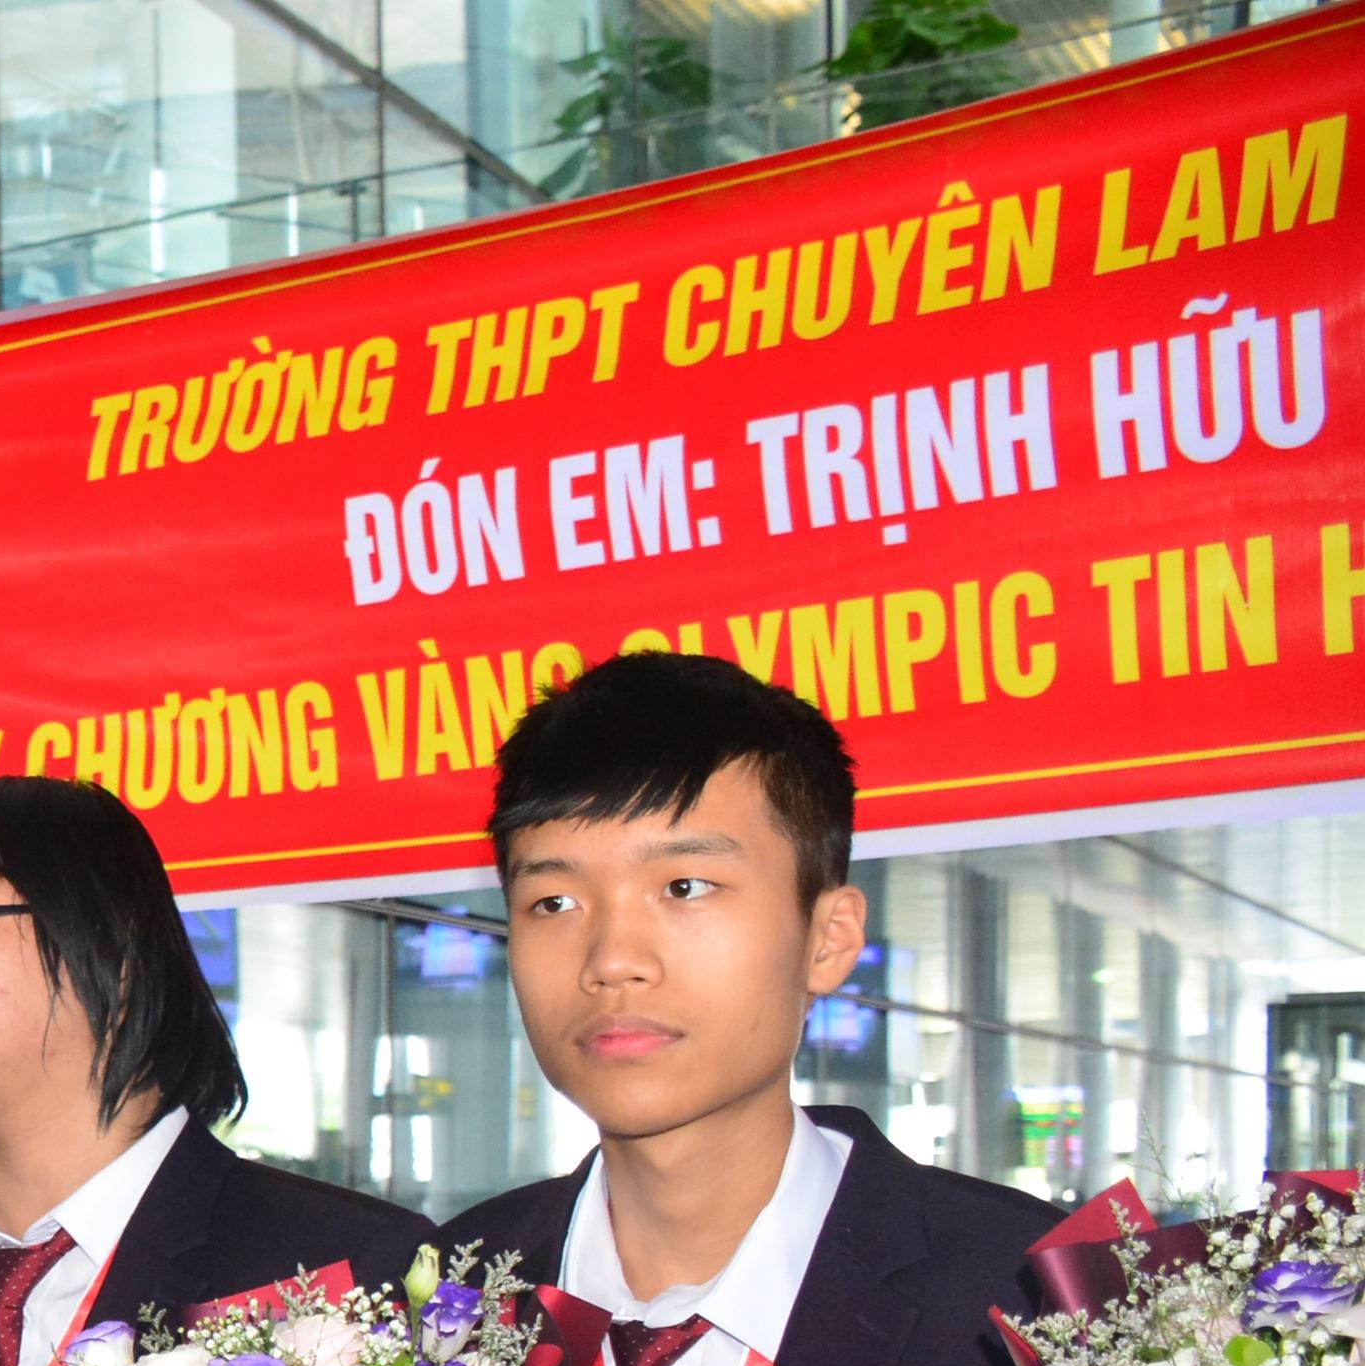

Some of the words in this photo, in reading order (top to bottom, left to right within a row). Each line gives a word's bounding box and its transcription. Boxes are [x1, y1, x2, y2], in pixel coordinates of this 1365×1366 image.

[88, 336, 397, 481] TRƯỜNG
[426, 283, 640, 414] THPT
[665, 182, 1062, 367] CHUYÊN
[1095, 116, 1347, 275] LAM
[345, 458, 525, 606] ĐÓN
[550, 435, 722, 571] EM:
[747, 364, 1057, 546] TRỊNH
[1092, 294, 1325, 479] HỮU
[26, 682, 338, 810] CHƯƠNG
[620, 571, 1057, 721] YMPIC
[1092, 535, 1278, 684] TIN
